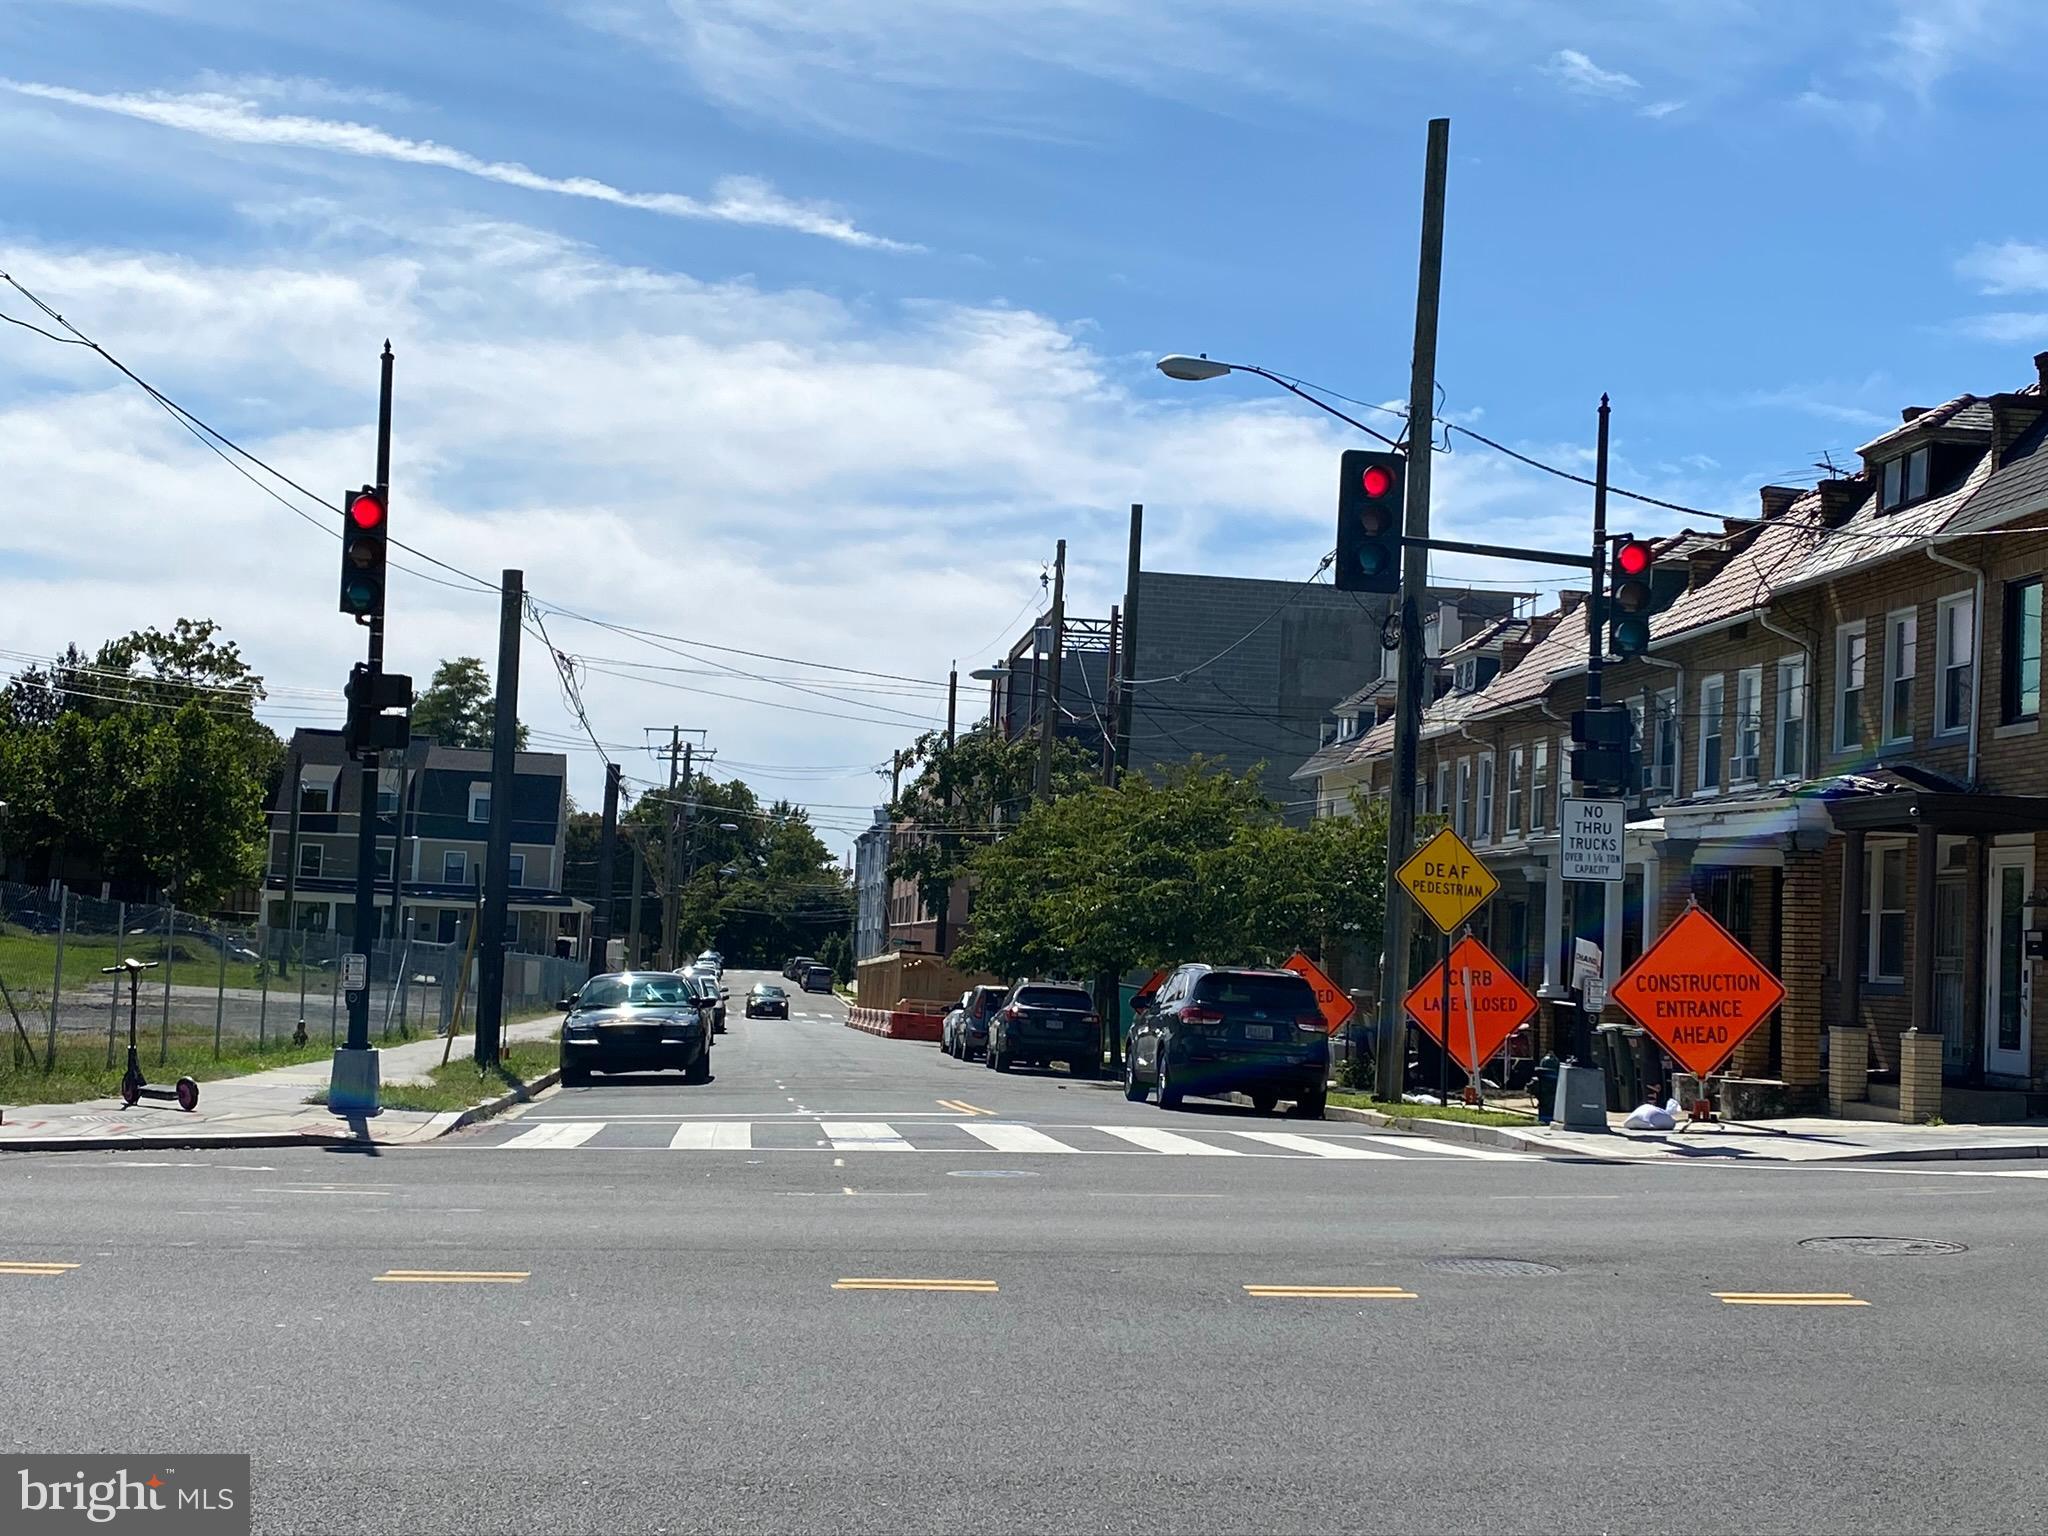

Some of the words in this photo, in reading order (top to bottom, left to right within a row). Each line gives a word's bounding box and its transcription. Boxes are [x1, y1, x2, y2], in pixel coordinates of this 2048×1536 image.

[1583, 805, 1603, 818] NO
[1574, 821, 1612, 835] THRU
[1569, 837, 1617, 851] TRUCKS
[1565, 852, 1583, 862] OVER
[1607, 854, 1620, 863] TON
[1424, 862, 1470, 880] DEAF
[1574, 864, 1609, 875] CAPACITY
[1412, 880, 1482, 897] PEDESTRIAN
[1636, 974, 1760, 993] CONSTRUCTION
[1423, 997, 1459, 1011] LAE
[1656, 1000, 1743, 1018] ENTRANCE
[1672, 1026, 1728, 1044] AHEAD
